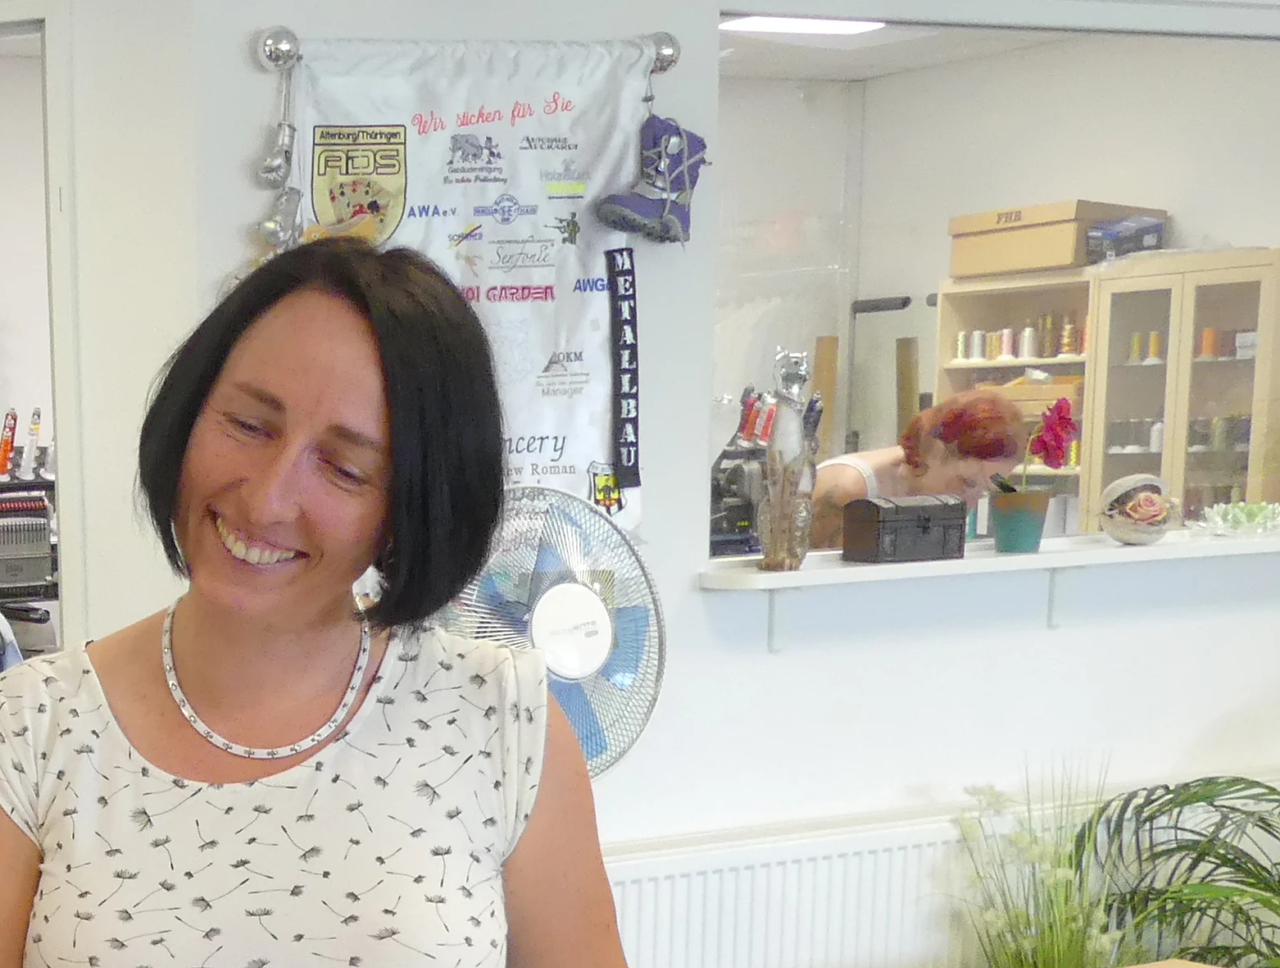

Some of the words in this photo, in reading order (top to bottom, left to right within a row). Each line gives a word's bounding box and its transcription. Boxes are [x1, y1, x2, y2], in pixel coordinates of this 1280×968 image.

[411, 110, 446, 136] Wir
[456, 105, 504, 127] sticken
[510, 101, 535, 127] für
[543, 91, 576, 115] Sie
[320, 130, 401, 142] Altenburg/Thüringen
[317, 149, 401, 176] ADS
[407, 205, 441, 219] AWA
[486, 285, 556, 301] GARDEN
[613, 251, 637, 467] METALLBAU
[531, 462, 576, 476] Roman
